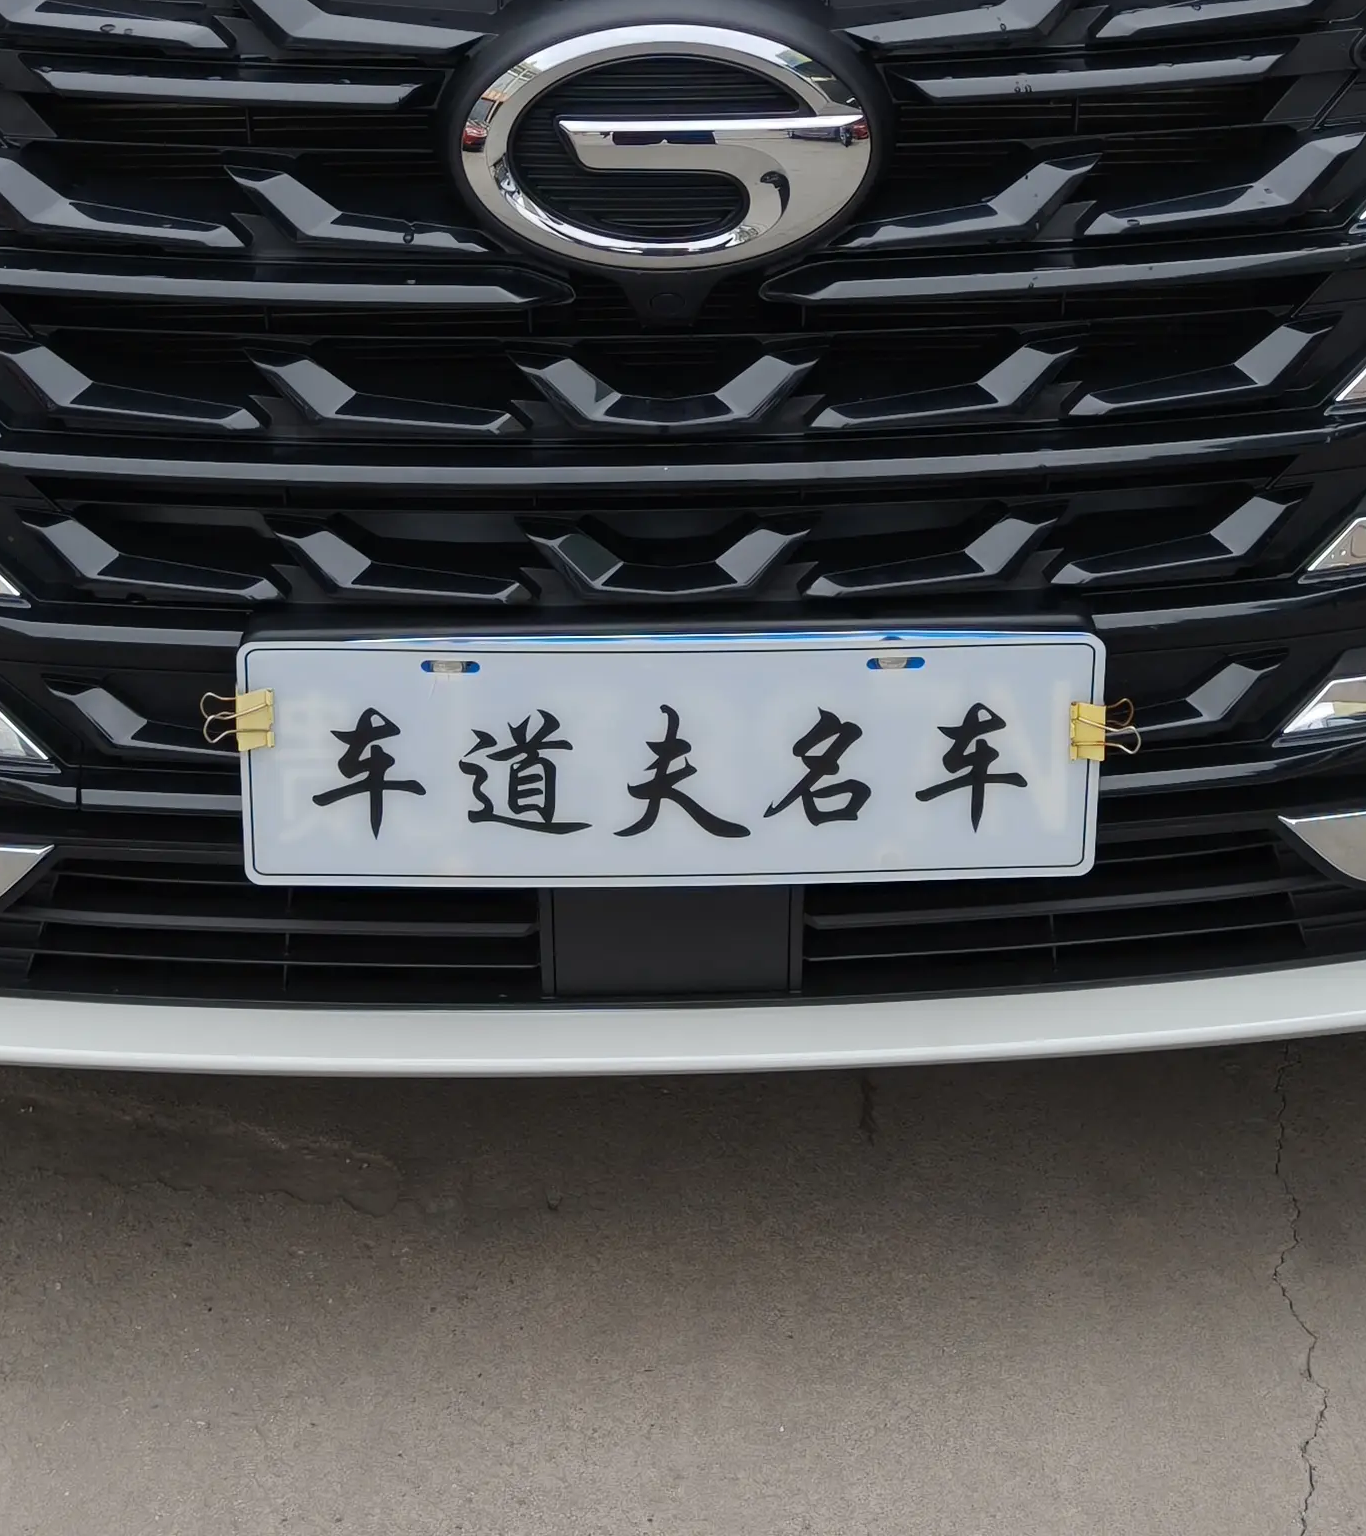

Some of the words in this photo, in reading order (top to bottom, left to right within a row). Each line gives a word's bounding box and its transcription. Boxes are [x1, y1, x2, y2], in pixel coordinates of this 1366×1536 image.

[311, 703, 1027, 840] 车道夫名车
